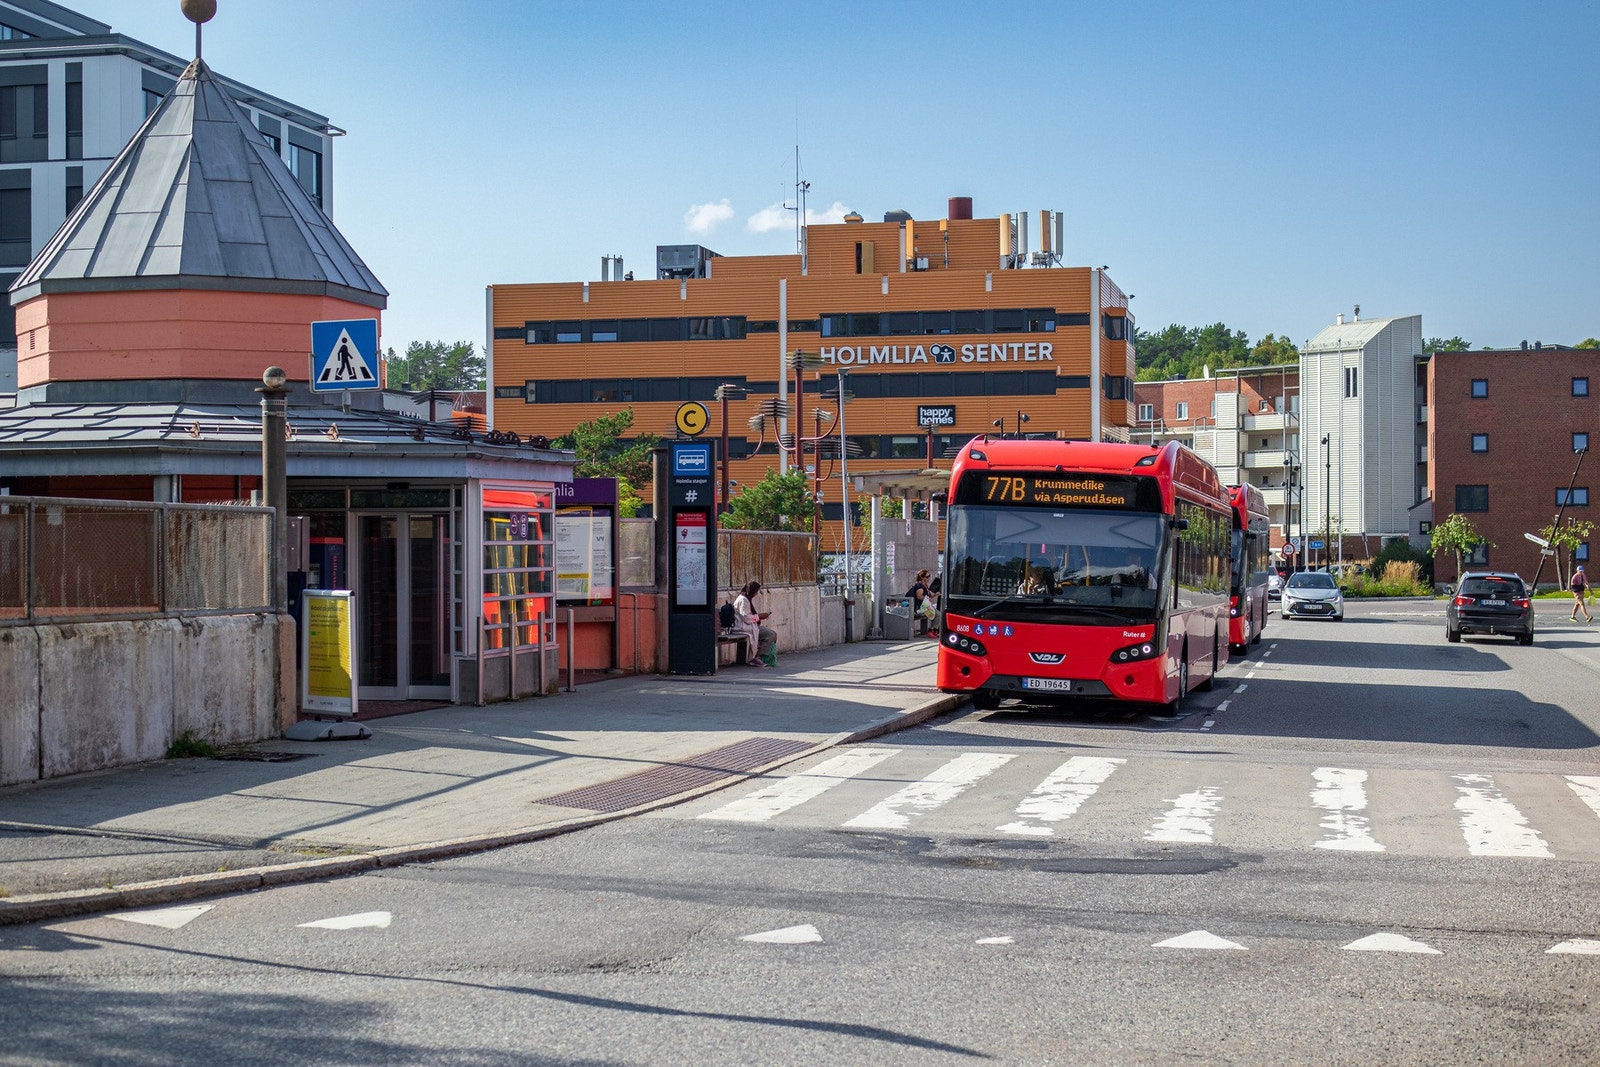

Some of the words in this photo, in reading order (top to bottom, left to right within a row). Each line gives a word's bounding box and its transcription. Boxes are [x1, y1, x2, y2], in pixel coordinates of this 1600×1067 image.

[820, 344, 928, 364] HOLMLIA
[961, 342, 1053, 363] SENTER
[683, 410, 697, 427] C
[920, 415, 954, 425] homes
[987, 476, 1026, 501] 77B
[1034, 479, 1105, 491] Krummedike
[1034, 492, 1051, 502] via
[1053, 492, 1126, 505] Asperudåsen
[1034, 653, 1059, 661] VDL
[1030, 679, 1041, 687] ED
[1043, 680, 1068, 689] 19645
